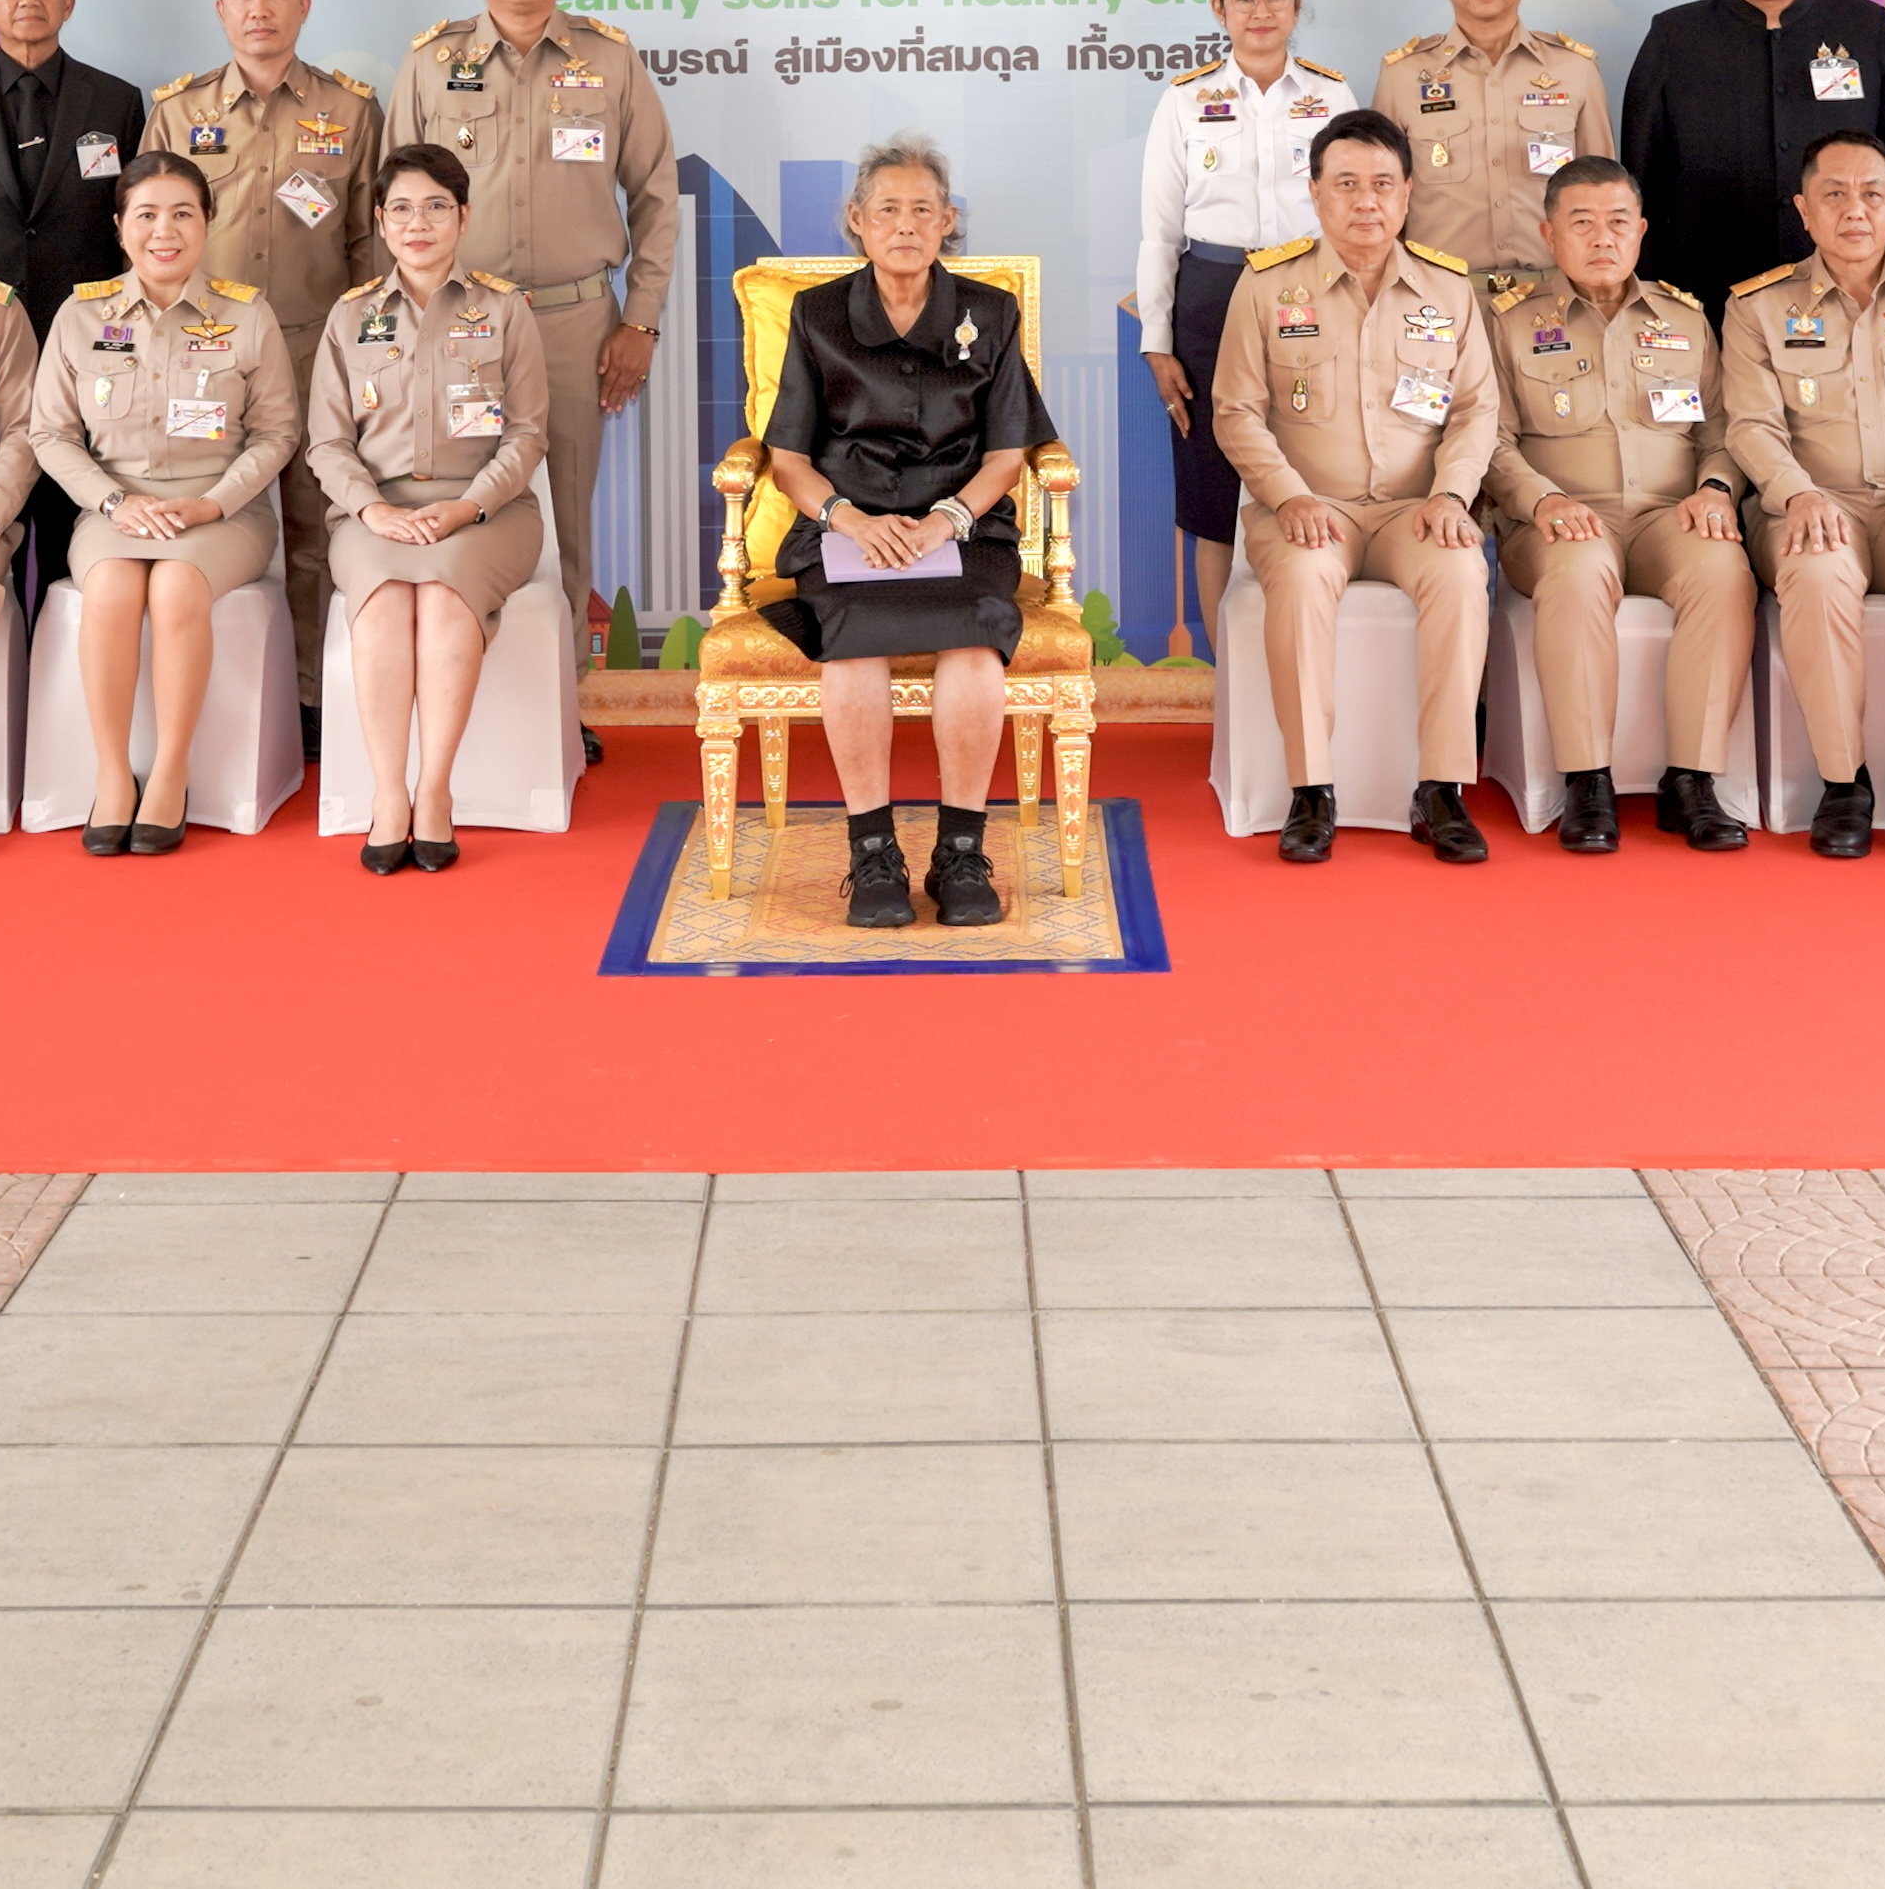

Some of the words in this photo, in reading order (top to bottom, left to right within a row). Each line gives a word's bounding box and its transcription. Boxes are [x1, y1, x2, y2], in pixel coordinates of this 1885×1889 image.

[775, 25, 1039, 84] สู่เมืองที่สมดุล
